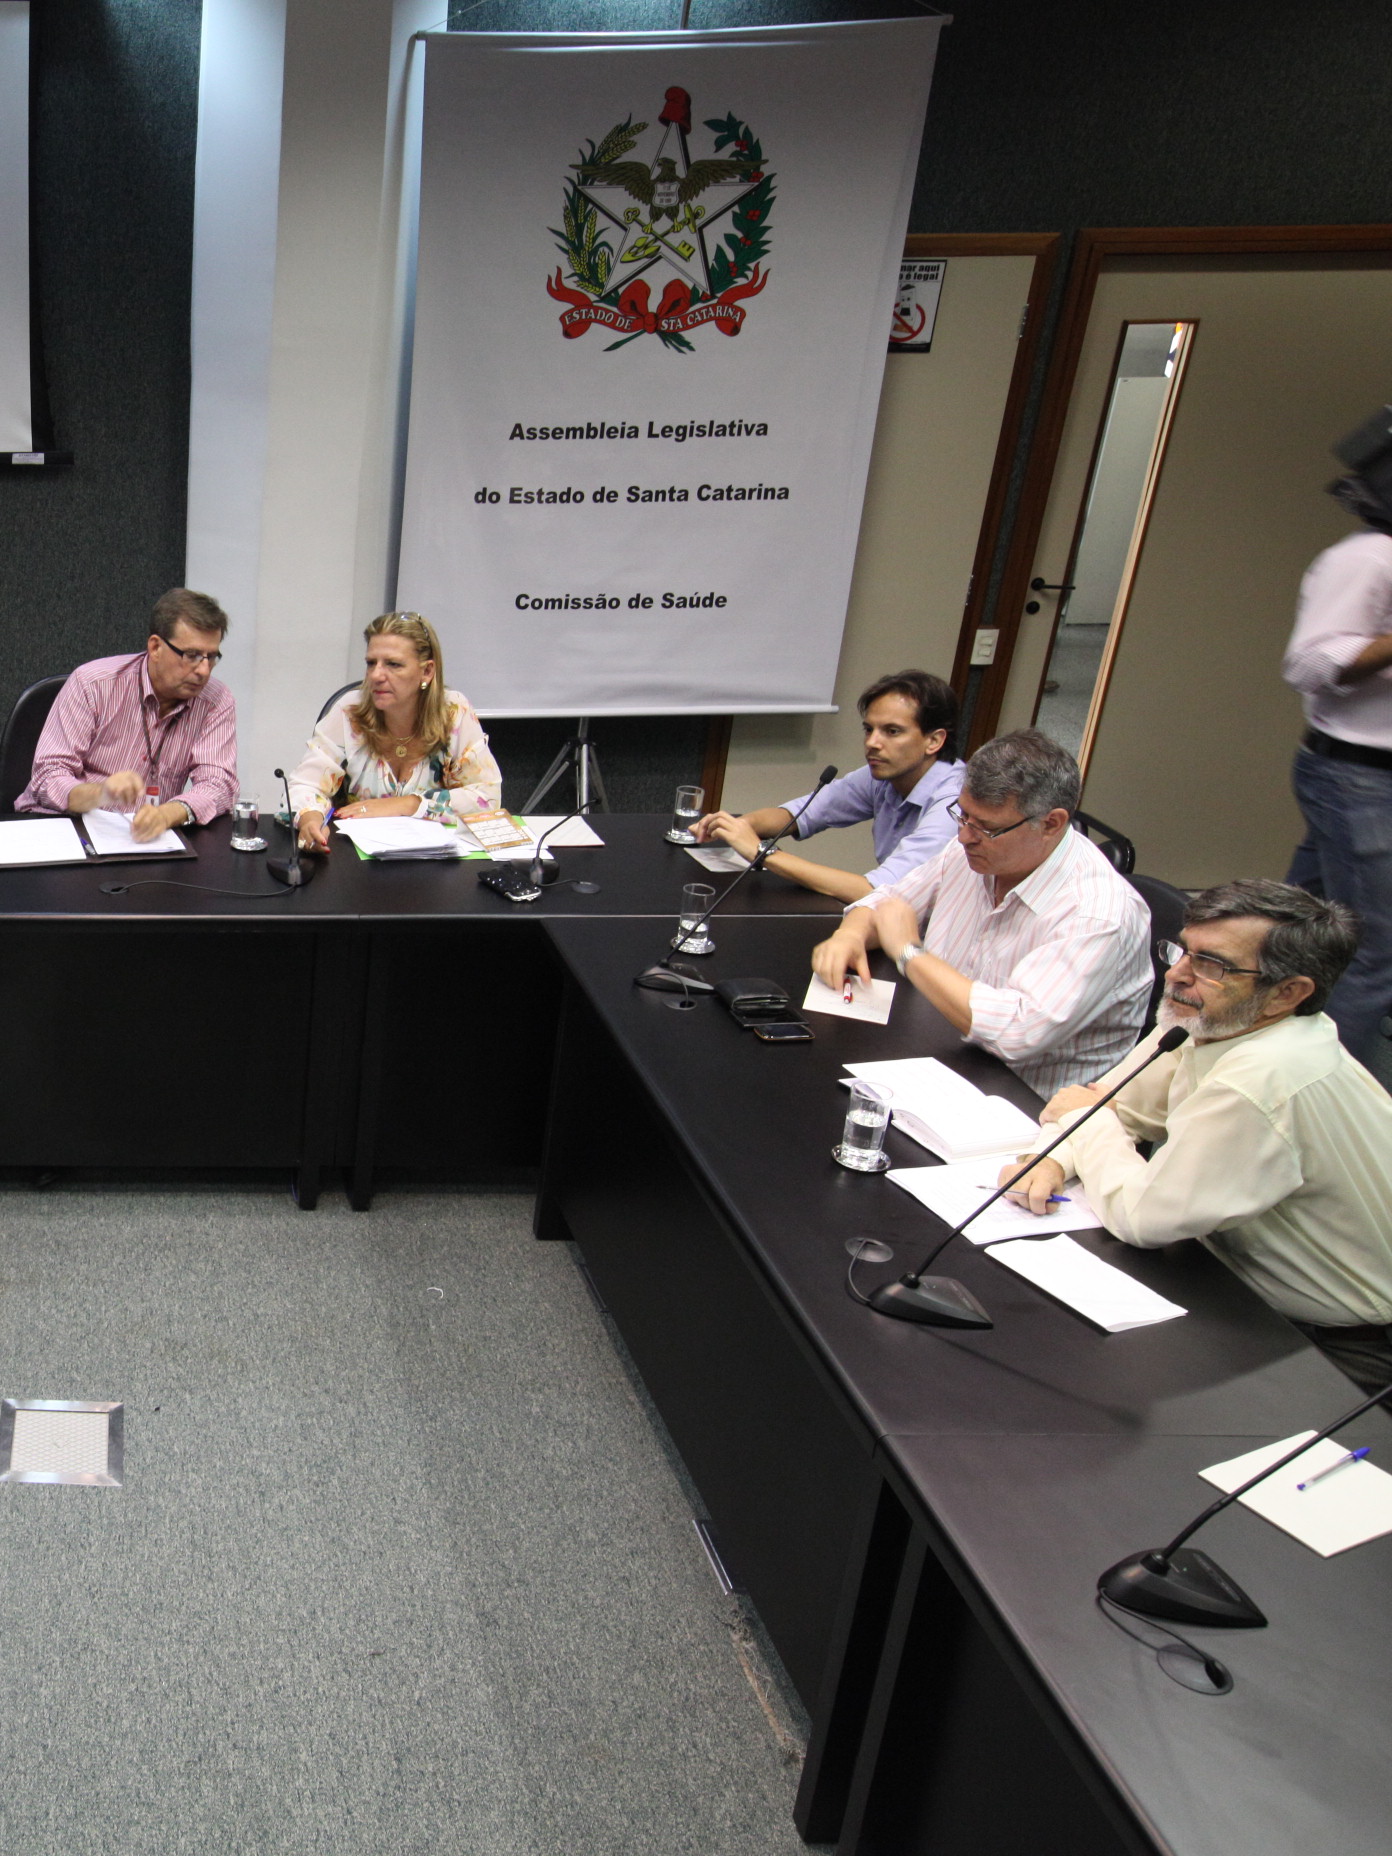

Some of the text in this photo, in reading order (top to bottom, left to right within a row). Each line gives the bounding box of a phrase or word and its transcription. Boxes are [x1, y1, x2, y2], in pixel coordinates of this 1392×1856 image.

[913, 272, 938, 280] legal
[565, 309, 614, 325] ESTADO
[615, 316, 633, 330] DE
[687, 305, 741, 325] CATARINA
[509, 419, 768, 442] Assembleia Legislativa
[474, 483, 789, 505] do Estado de Santa Catarina
[515, 592, 727, 610] Comissão de Saúde
